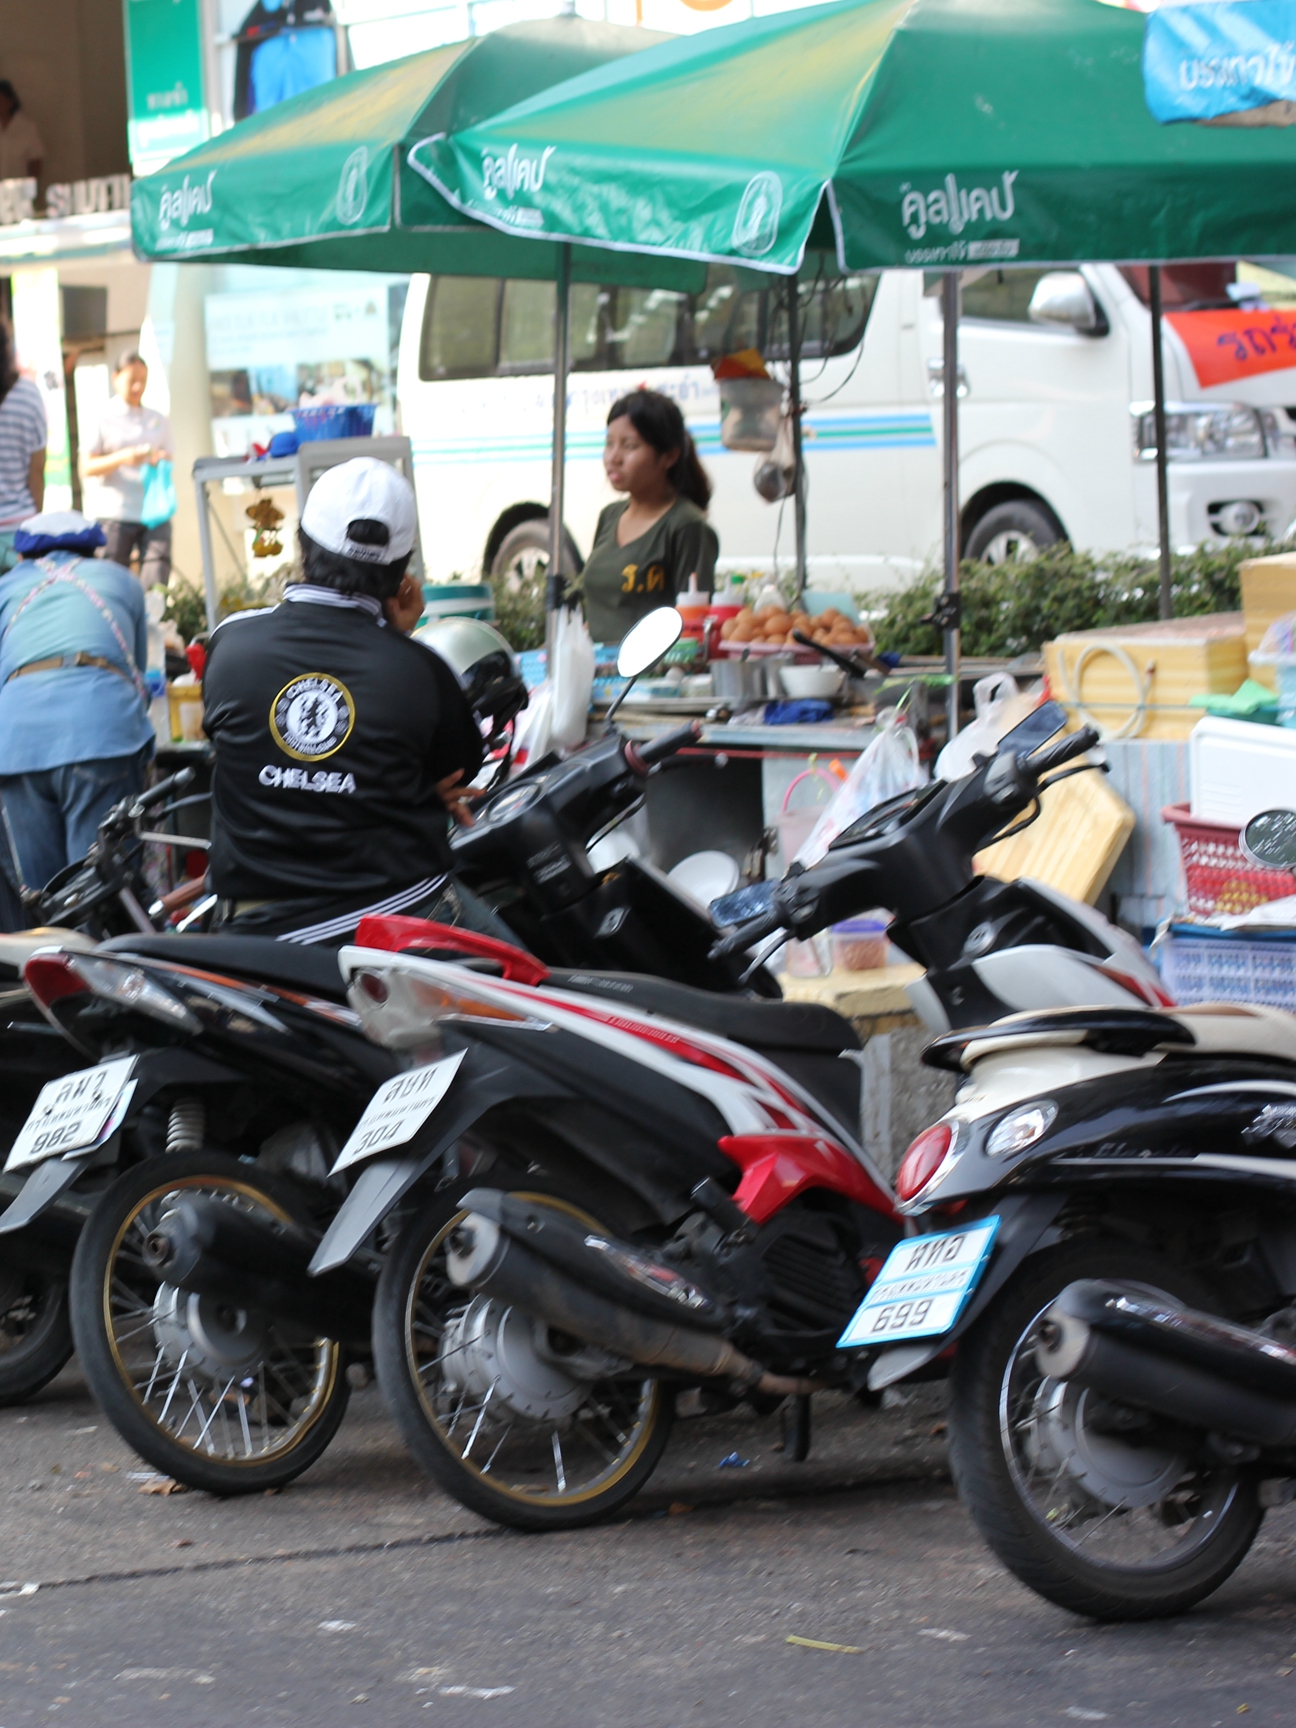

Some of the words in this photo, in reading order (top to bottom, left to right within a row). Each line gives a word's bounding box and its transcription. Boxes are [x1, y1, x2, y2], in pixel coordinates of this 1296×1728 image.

[258, 764, 357, 794] CHELSEA
[30, 1120, 83, 1155] 982
[352, 1118, 407, 1156] 304
[871, 1297, 935, 1334] 699
